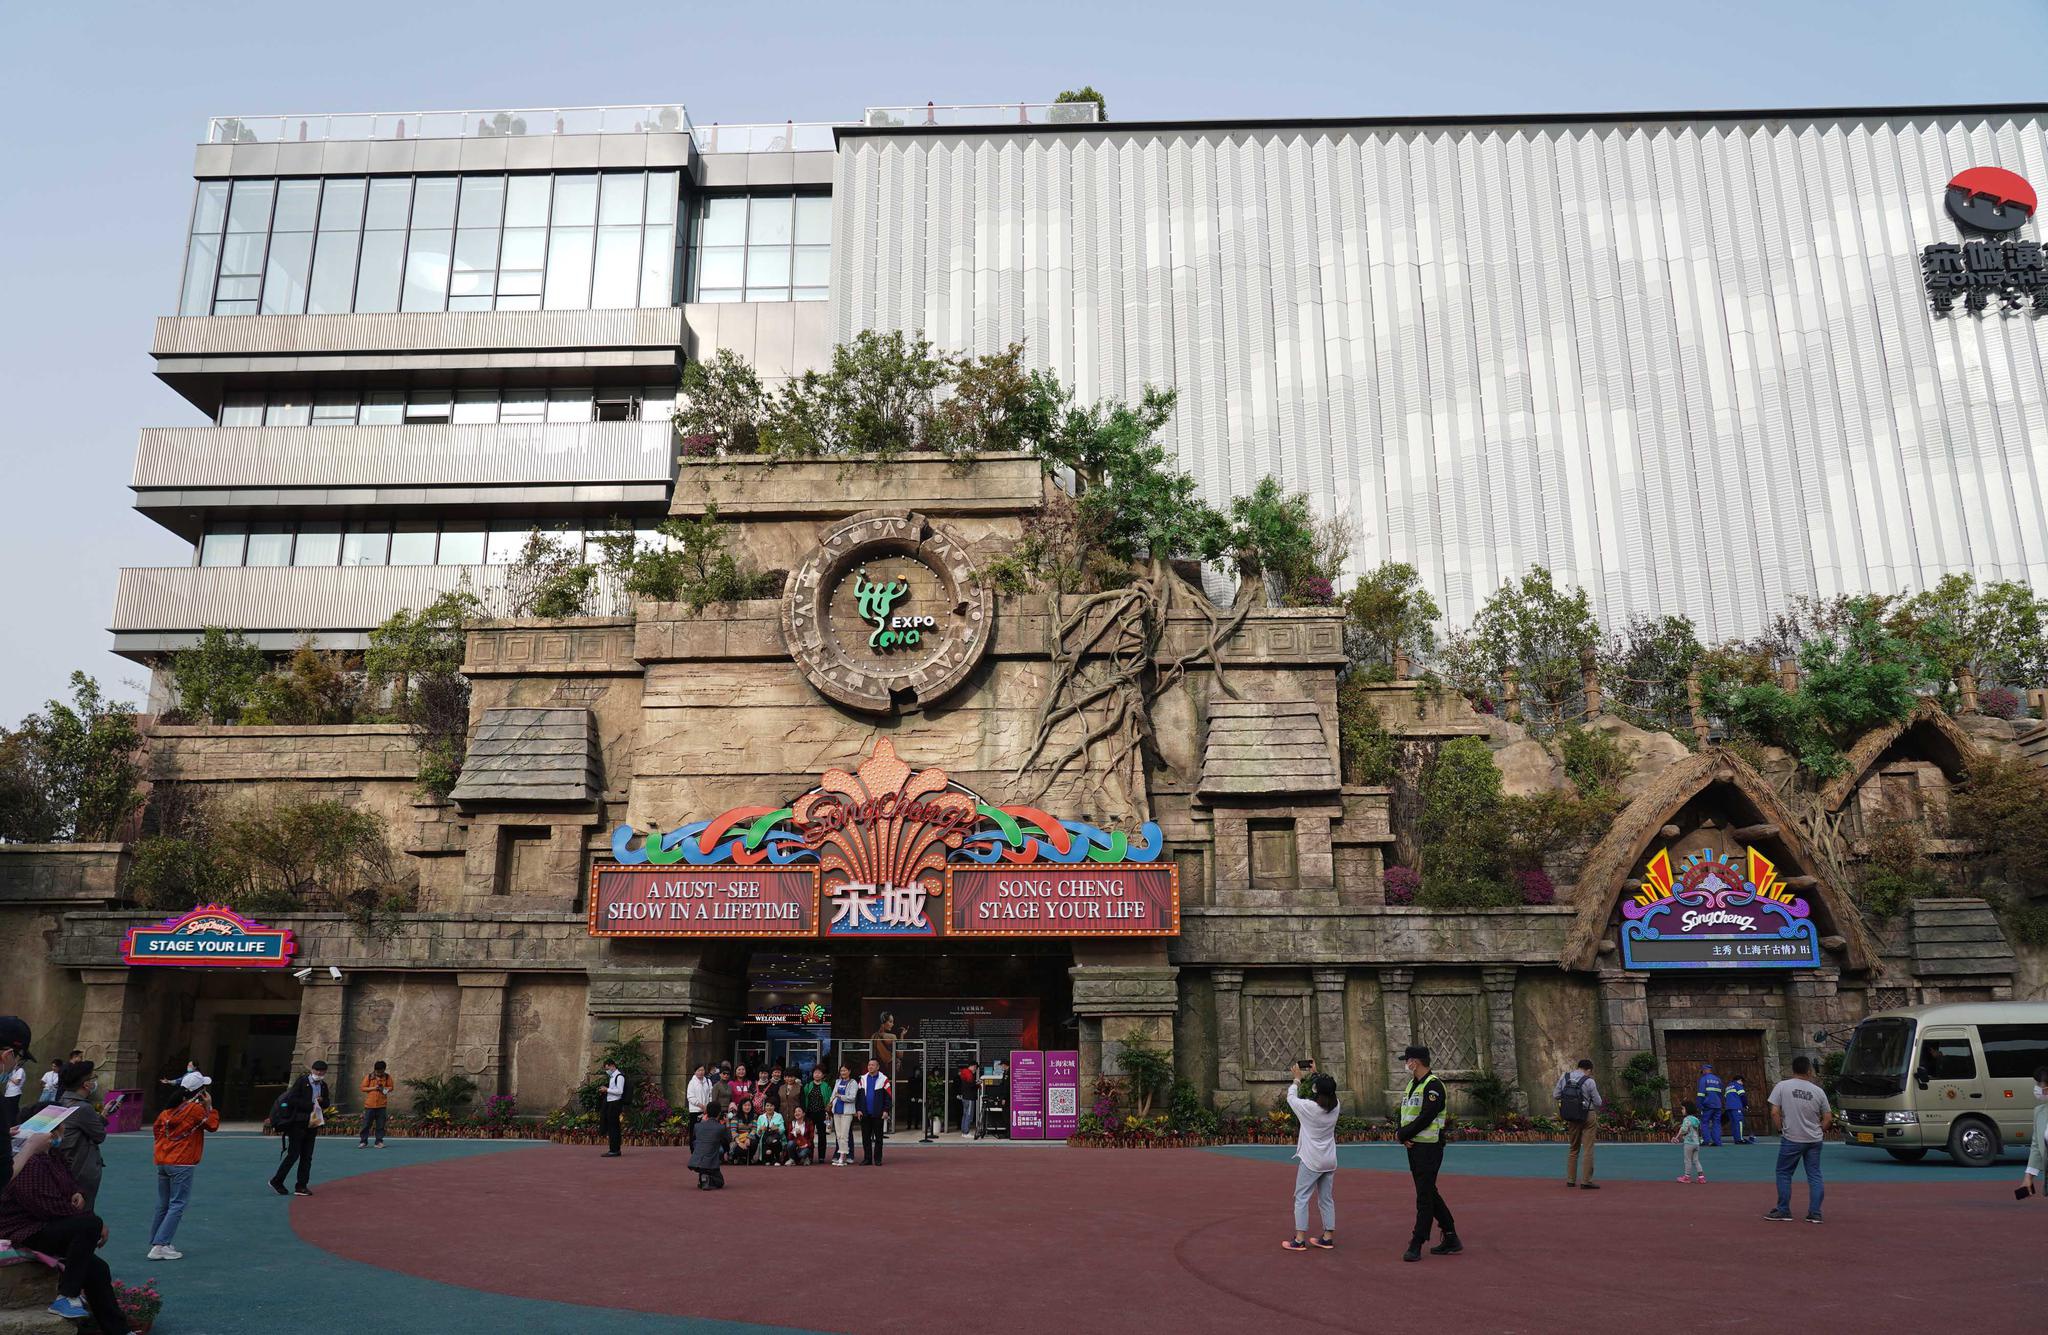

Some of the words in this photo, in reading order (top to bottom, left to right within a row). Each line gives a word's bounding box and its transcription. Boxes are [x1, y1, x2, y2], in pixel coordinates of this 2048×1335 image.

[892, 616, 935, 628] EXPO
[647, 881, 661, 898] A
[665, 881, 760, 898] MUST-SEE
[999, 880, 1052, 898] SONG
[1058, 880, 1124, 898] CHENG
[608, 902, 665, 920] SHOW
[670, 902, 690, 920] IN
[695, 902, 709, 920] A
[713, 902, 800, 920] LIFETIME
[832, 881, 927, 928] 宋城
[979, 901, 1040, 919] STAGE
[1046, 901, 1100, 919] YOUR
[1106, 901, 1146, 919] LIFE
[149, 940, 194, 951] STAGE
[197, 941, 234, 952] YOUR
[237, 941, 266, 952] LIFE
